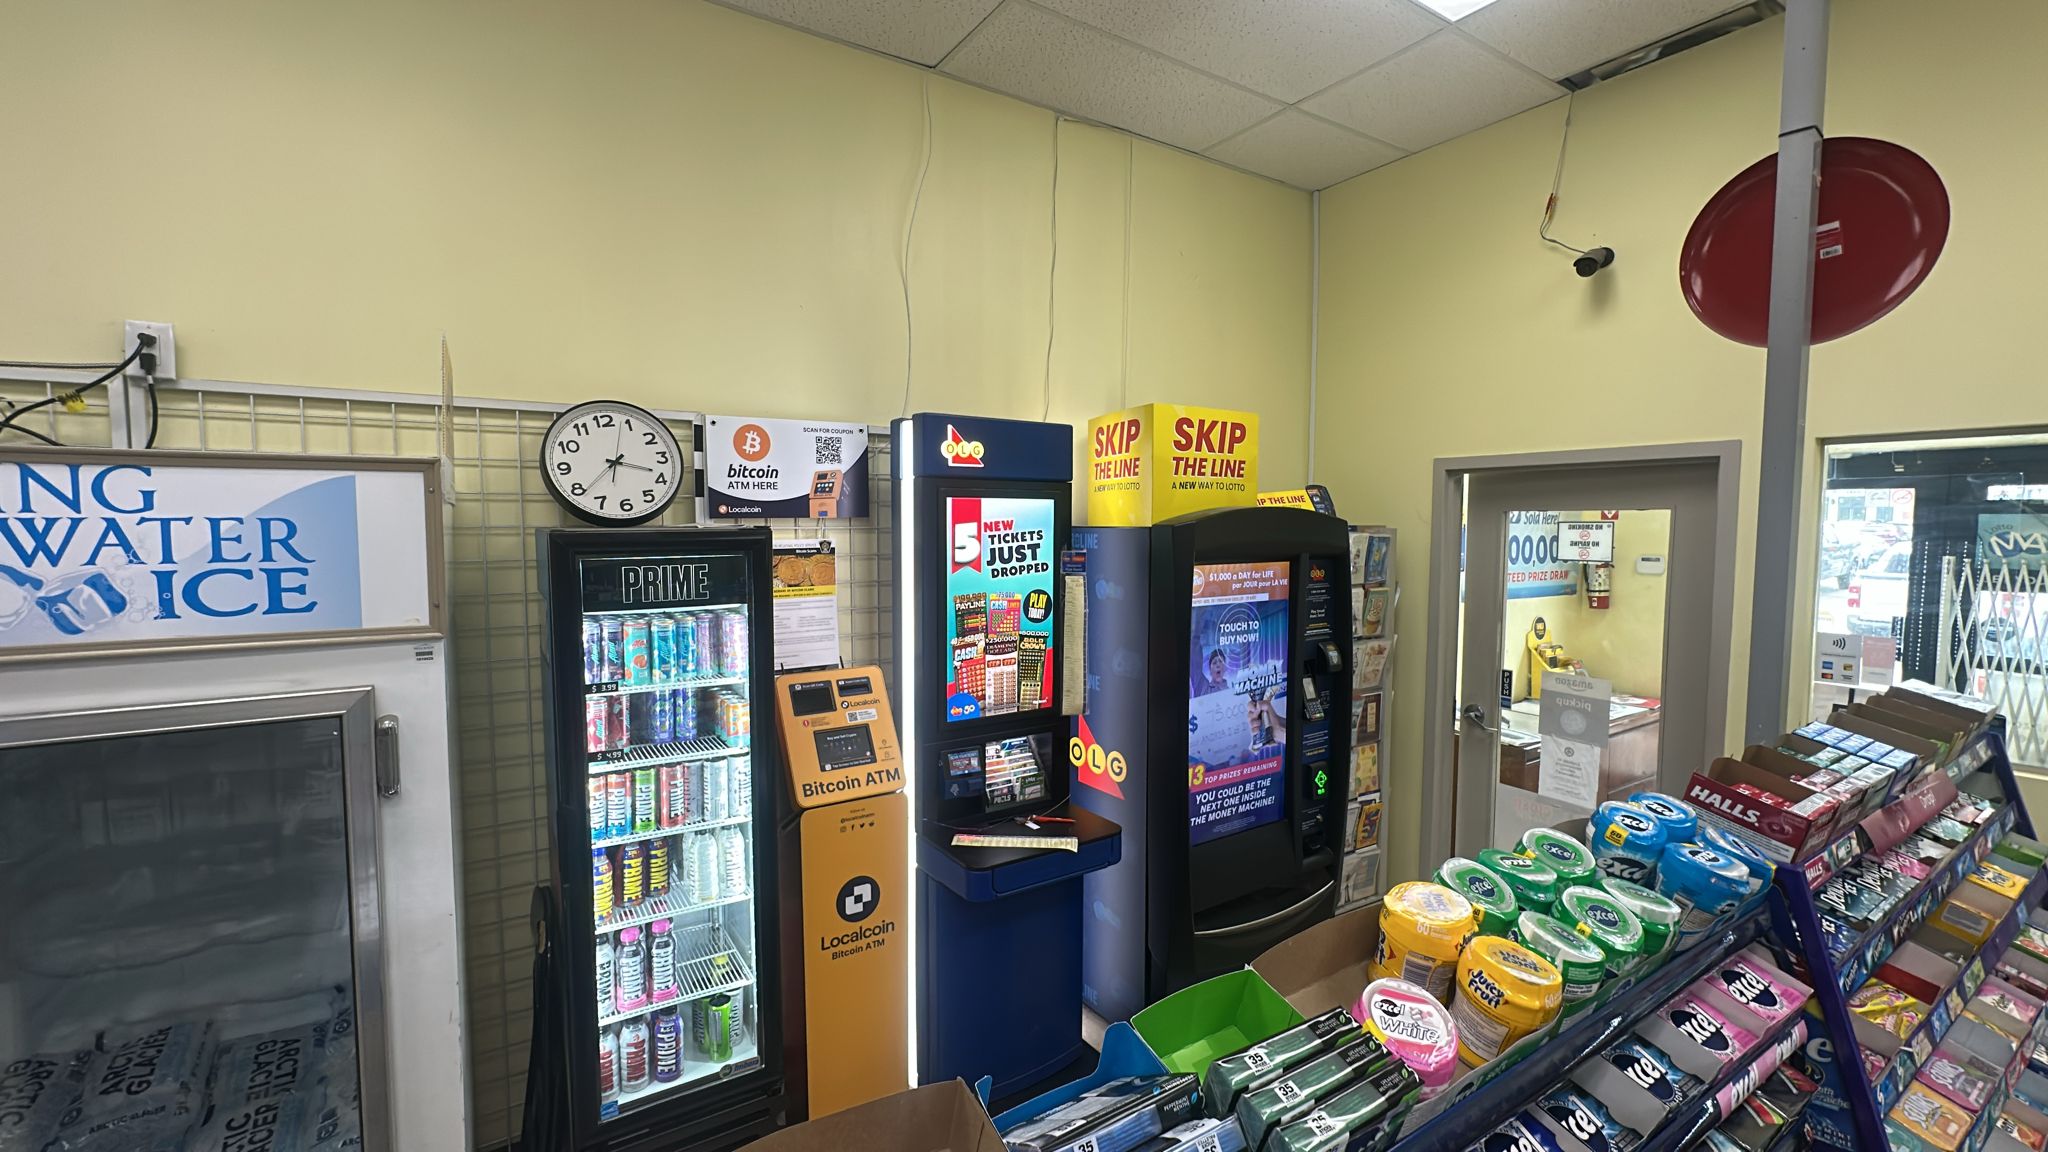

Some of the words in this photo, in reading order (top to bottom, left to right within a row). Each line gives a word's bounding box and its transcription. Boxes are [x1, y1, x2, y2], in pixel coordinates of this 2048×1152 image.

[593, 415, 615, 428] 12
[625, 419, 633, 431] 1
[573, 423, 589, 436] 11
[1173, 416, 1247, 455] SKIP
[643, 433, 658, 445] 2
[1094, 418, 1141, 459] SKIP
[558, 440, 580, 454] 10
[947, 444, 981, 456] OLG
[656, 451, 668, 464] 3
[557, 462, 571, 475] 9
[728, 464, 779, 479] bitcoin
[1094, 460, 1112, 480] THE
[1113, 457, 1141, 478] LINE
[1172, 456, 1206, 477] THE
[1210, 458, 1246, 478] LINE
[655, 472, 667, 485] 4
[728, 481, 750, 490] ATM
[752, 481, 778, 490] HERE
[0, 463, 157, 514] NG
[571, 483, 586, 496] 8
[1124, 482, 1140, 491] LOTTO
[1172, 481, 1177, 490] A
[1179, 481, 1196, 490] NEW
[1198, 481, 1214, 490] WAY
[1216, 481, 1225, 490] TO
[1225, 482, 1245, 492] LOTTO
[594, 496, 607, 510] 7
[642, 490, 655, 503] 5
[1286, 495, 1306, 503] LINE
[620, 499, 633, 512] 6
[729, 505, 762, 513] Localcoin
[1524, 512, 1540, 524] Sold
[0, 517, 316, 568] WATER
[955, 522, 980, 564] 5
[984, 520, 1014, 533] NEW
[988, 530, 1044, 546] TICKETS
[986, 543, 1041, 567] JUST
[991, 562, 1049, 579] DROPPED
[1209, 572, 1232, 581] $1,000
[1238, 571, 1251, 579] DAY
[1252, 571, 1260, 579] for
[1262, 570, 1274, 578] LIFE
[1528, 571, 1548, 582] PRIZE
[1550, 570, 1569, 580] DRAW
[622, 564, 709, 604] PRIME
[154, 567, 318, 620] ICE
[1029, 593, 1047, 608] PLAY
[956, 601, 986, 611] PAYLINE
[990, 601, 1008, 610] CASH
[1220, 622, 1248, 633] TOUCH
[1248, 621, 1259, 630] TO
[1220, 636, 1235, 645] BUY
[1236, 633, 1259, 643] NOW!
[601, 683, 617, 692] 3.99
[1235, 673, 1282, 694] MACHINE
[850, 698, 880, 707] Localcoin
[1189, 715, 1199, 734] $
[606, 751, 622, 759] 4.99
[1071, 743, 1124, 776] OLG
[1204, 775, 1218, 784] TOP
[1243, 761, 1278, 775] REMAINING
[802, 776, 861, 797] Bitcoin
[865, 767, 901, 786] ATM
[1195, 791, 1216, 805] YOU
[1217, 784, 1244, 798] COULD
[1245, 782, 1255, 792] BE
[1257, 778, 1272, 789] THE
[636, 785, 651, 823] PRIME
[670, 780, 685, 819] PRIME
[1200, 802, 1222, 814] NEXT
[1223, 796, 1240, 807] ONE
[1241, 788, 1267, 802] INSIDE
[1190, 817, 1207, 827] THE
[1208, 808, 1237, 822] MONEY
[1238, 796, 1275, 813] MACHINE!
[1614, 815, 1654, 831] excel
[1610, 830, 1623, 839] 60
[1542, 842, 1576, 860] excel
[1805, 863, 1823, 881] HALLS
[1470, 877, 1494, 896] excel
[1587, 909, 1620, 924] excel
[1417, 920, 1430, 935] 60
[820, 920, 895, 952] Localcoin
[831, 943, 863, 961] Bitcoin
[865, 938, 885, 949] ATM
[652, 946, 674, 991] PRIME
[1471, 969, 1505, 998] Juicy
[1728, 962, 1770, 1005] excel
[1468, 979, 1502, 1009] Fruit
[1374, 1001, 1406, 1016] excel
[126, 1026, 173, 1095] GLACIER
[657, 1033, 677, 1074] PRIME
[1247, 1052, 1263, 1065] 35
[1278, 1083, 1295, 1098] 35
[1311, 1115, 1327, 1129] 35
[1078, 1140, 1094, 1152] 35
